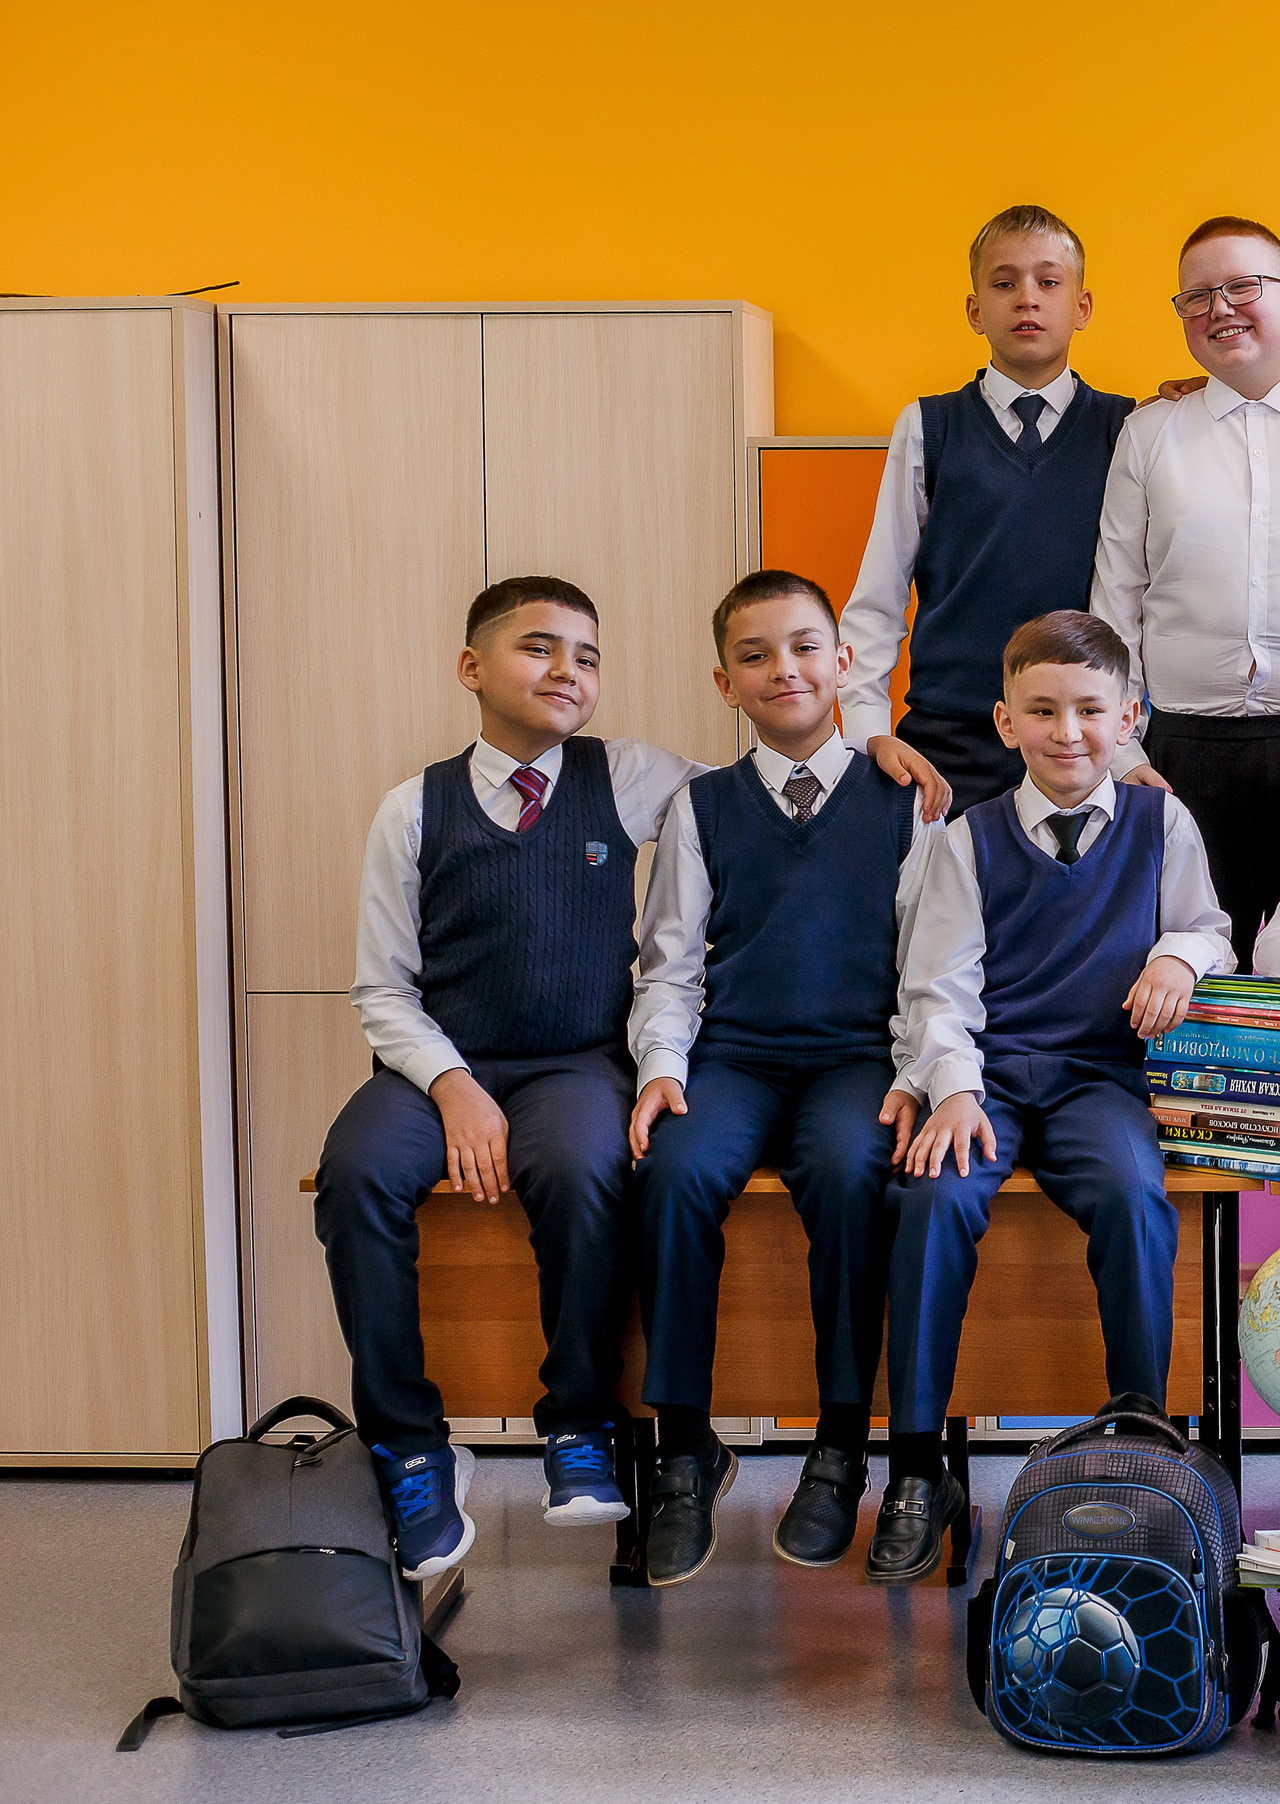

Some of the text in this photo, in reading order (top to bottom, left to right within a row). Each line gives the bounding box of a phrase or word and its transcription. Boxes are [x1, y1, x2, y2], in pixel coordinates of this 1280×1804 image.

[1166, 1037, 1250, 1062] МОРДОВИИ
[1253, 1048, 1265, 1063] О
[1230, 1079, 1256, 1093] КУХНЯ
[1208, 1119, 1279, 1133] ИСКУССТВО БРОСКОВ
[1165, 1126, 1213, 1141] СКАЗКИ
[1072, 1516, 1127, 1525] WINNER ONE
